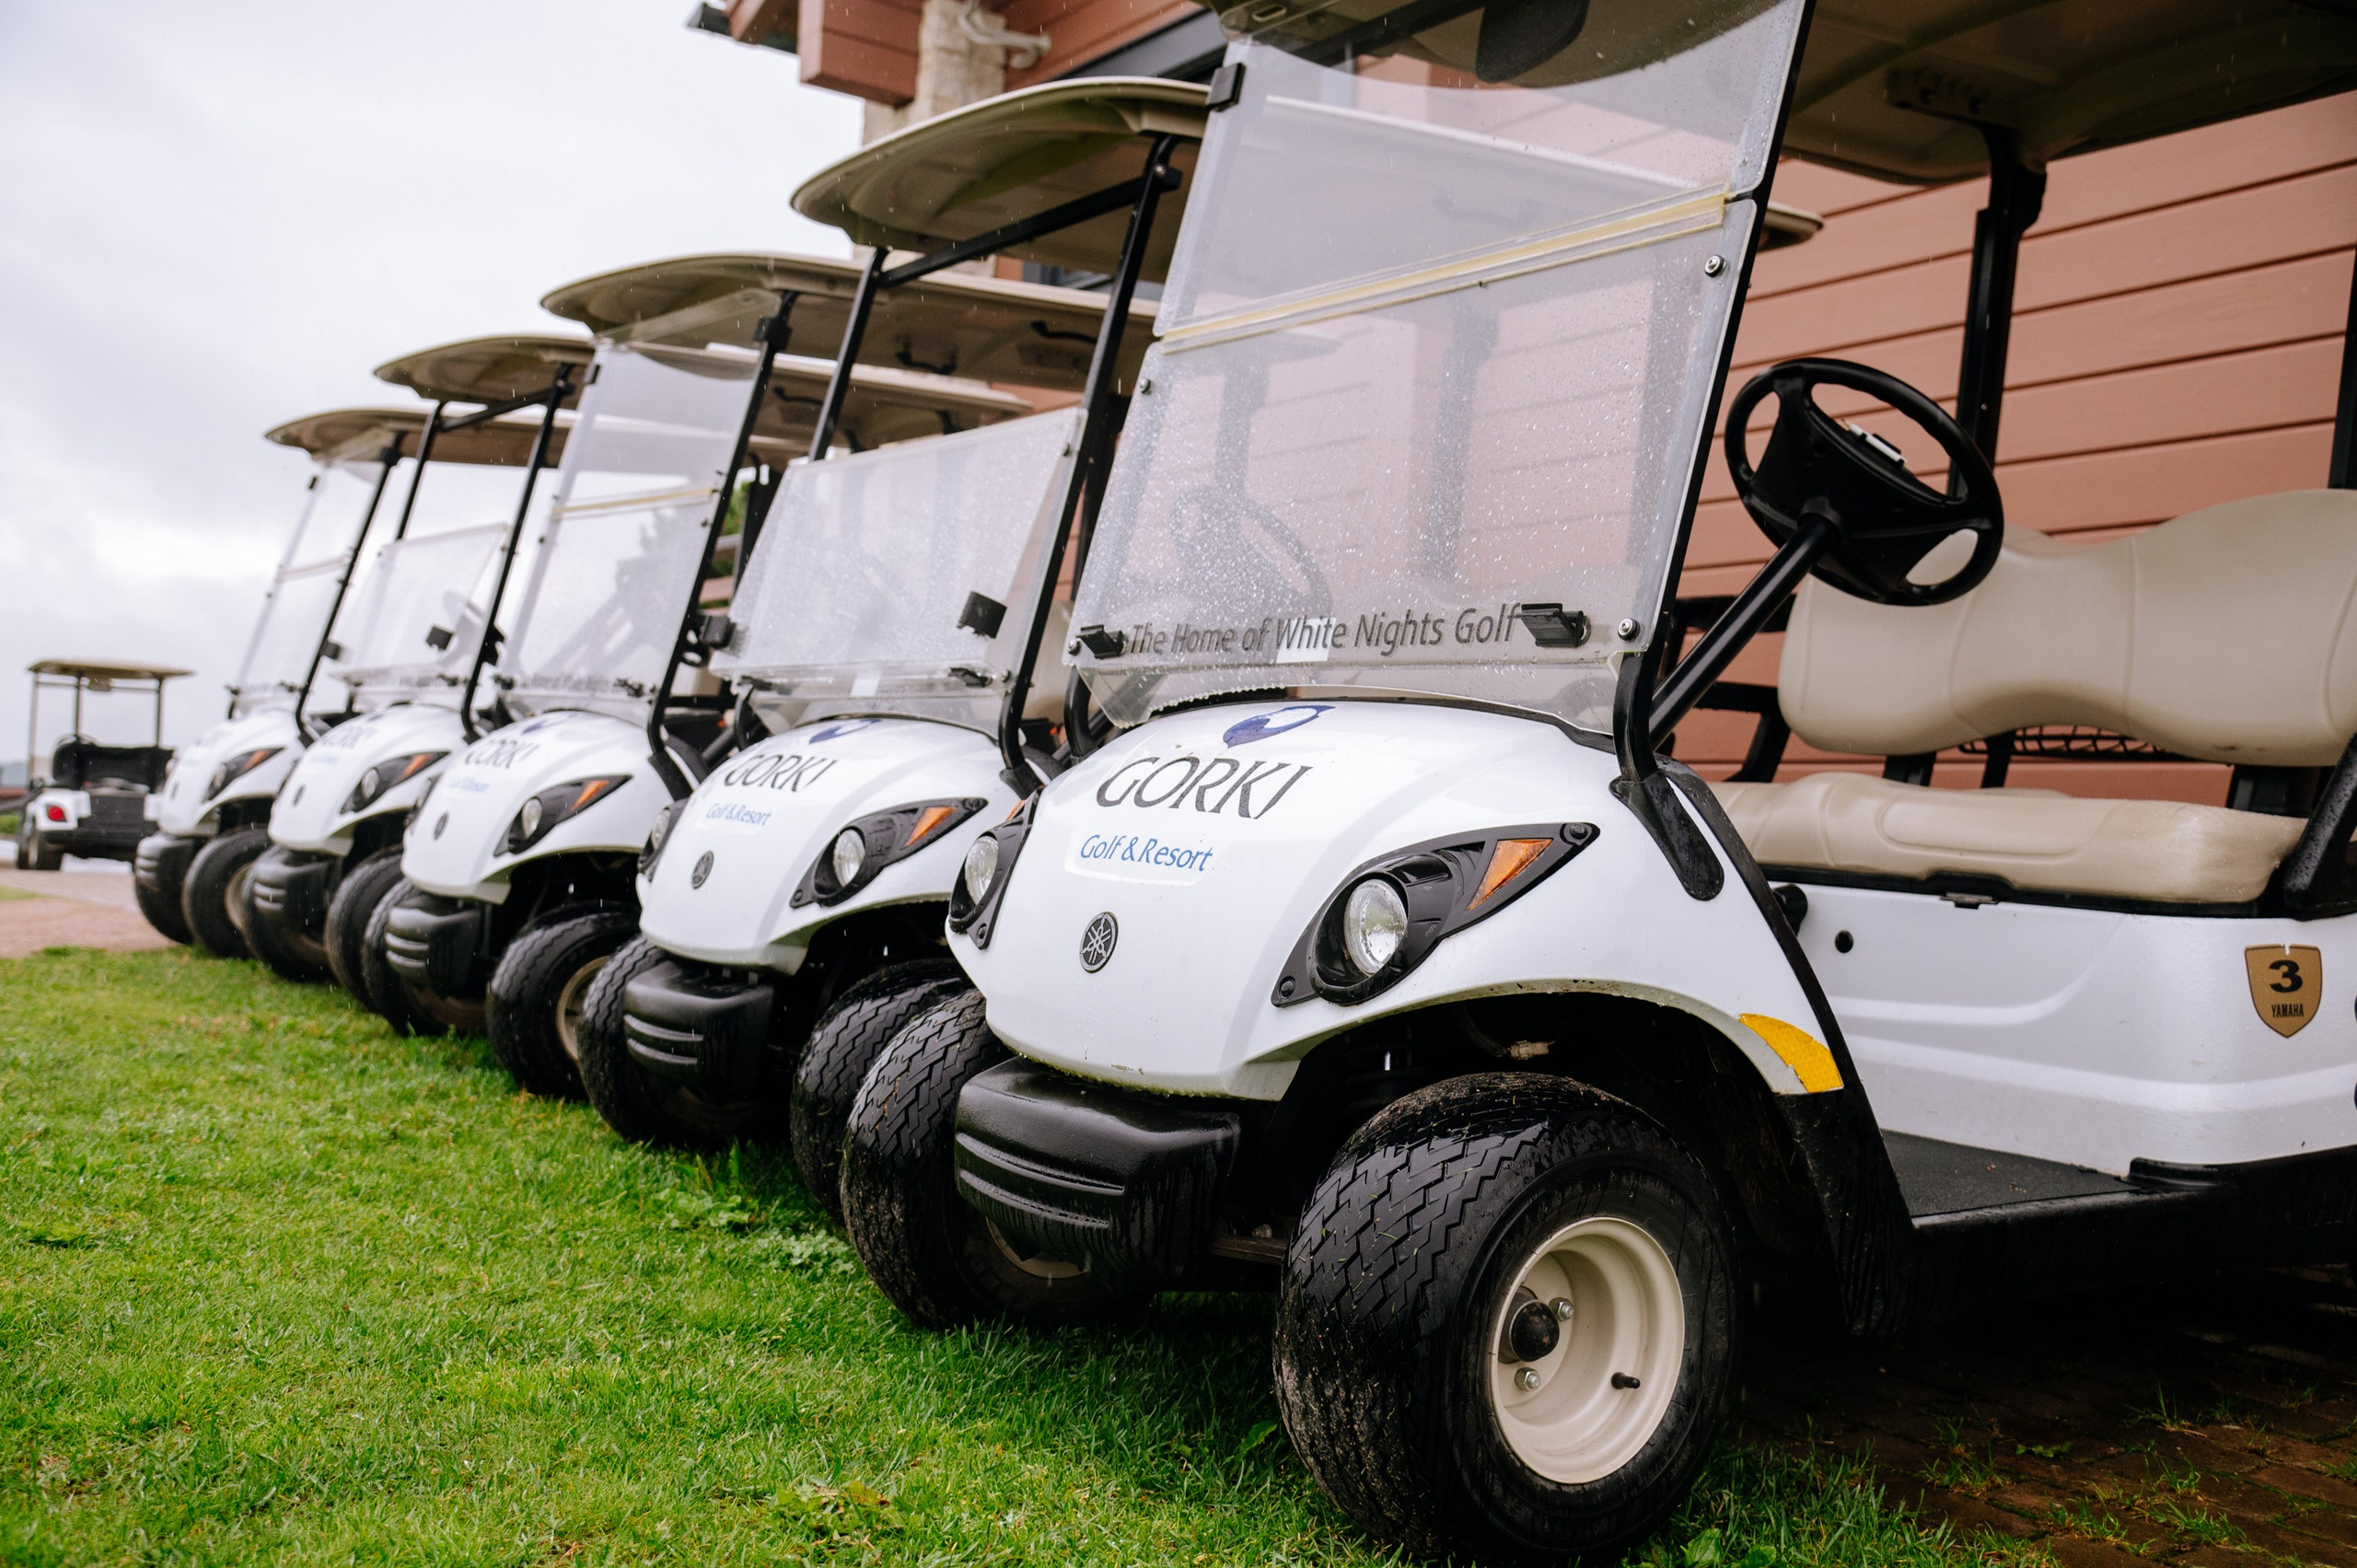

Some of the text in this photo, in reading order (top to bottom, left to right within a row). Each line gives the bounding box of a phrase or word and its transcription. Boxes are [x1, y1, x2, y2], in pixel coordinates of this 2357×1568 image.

[1131, 602, 1521, 656] The Home of White Nights Golf
[724, 753, 839, 793] GORKI
[1096, 756, 1315, 820] GORKI
[2269, 958, 2304, 993] 3
[2270, 1003, 2305, 1018] YAMAHA
